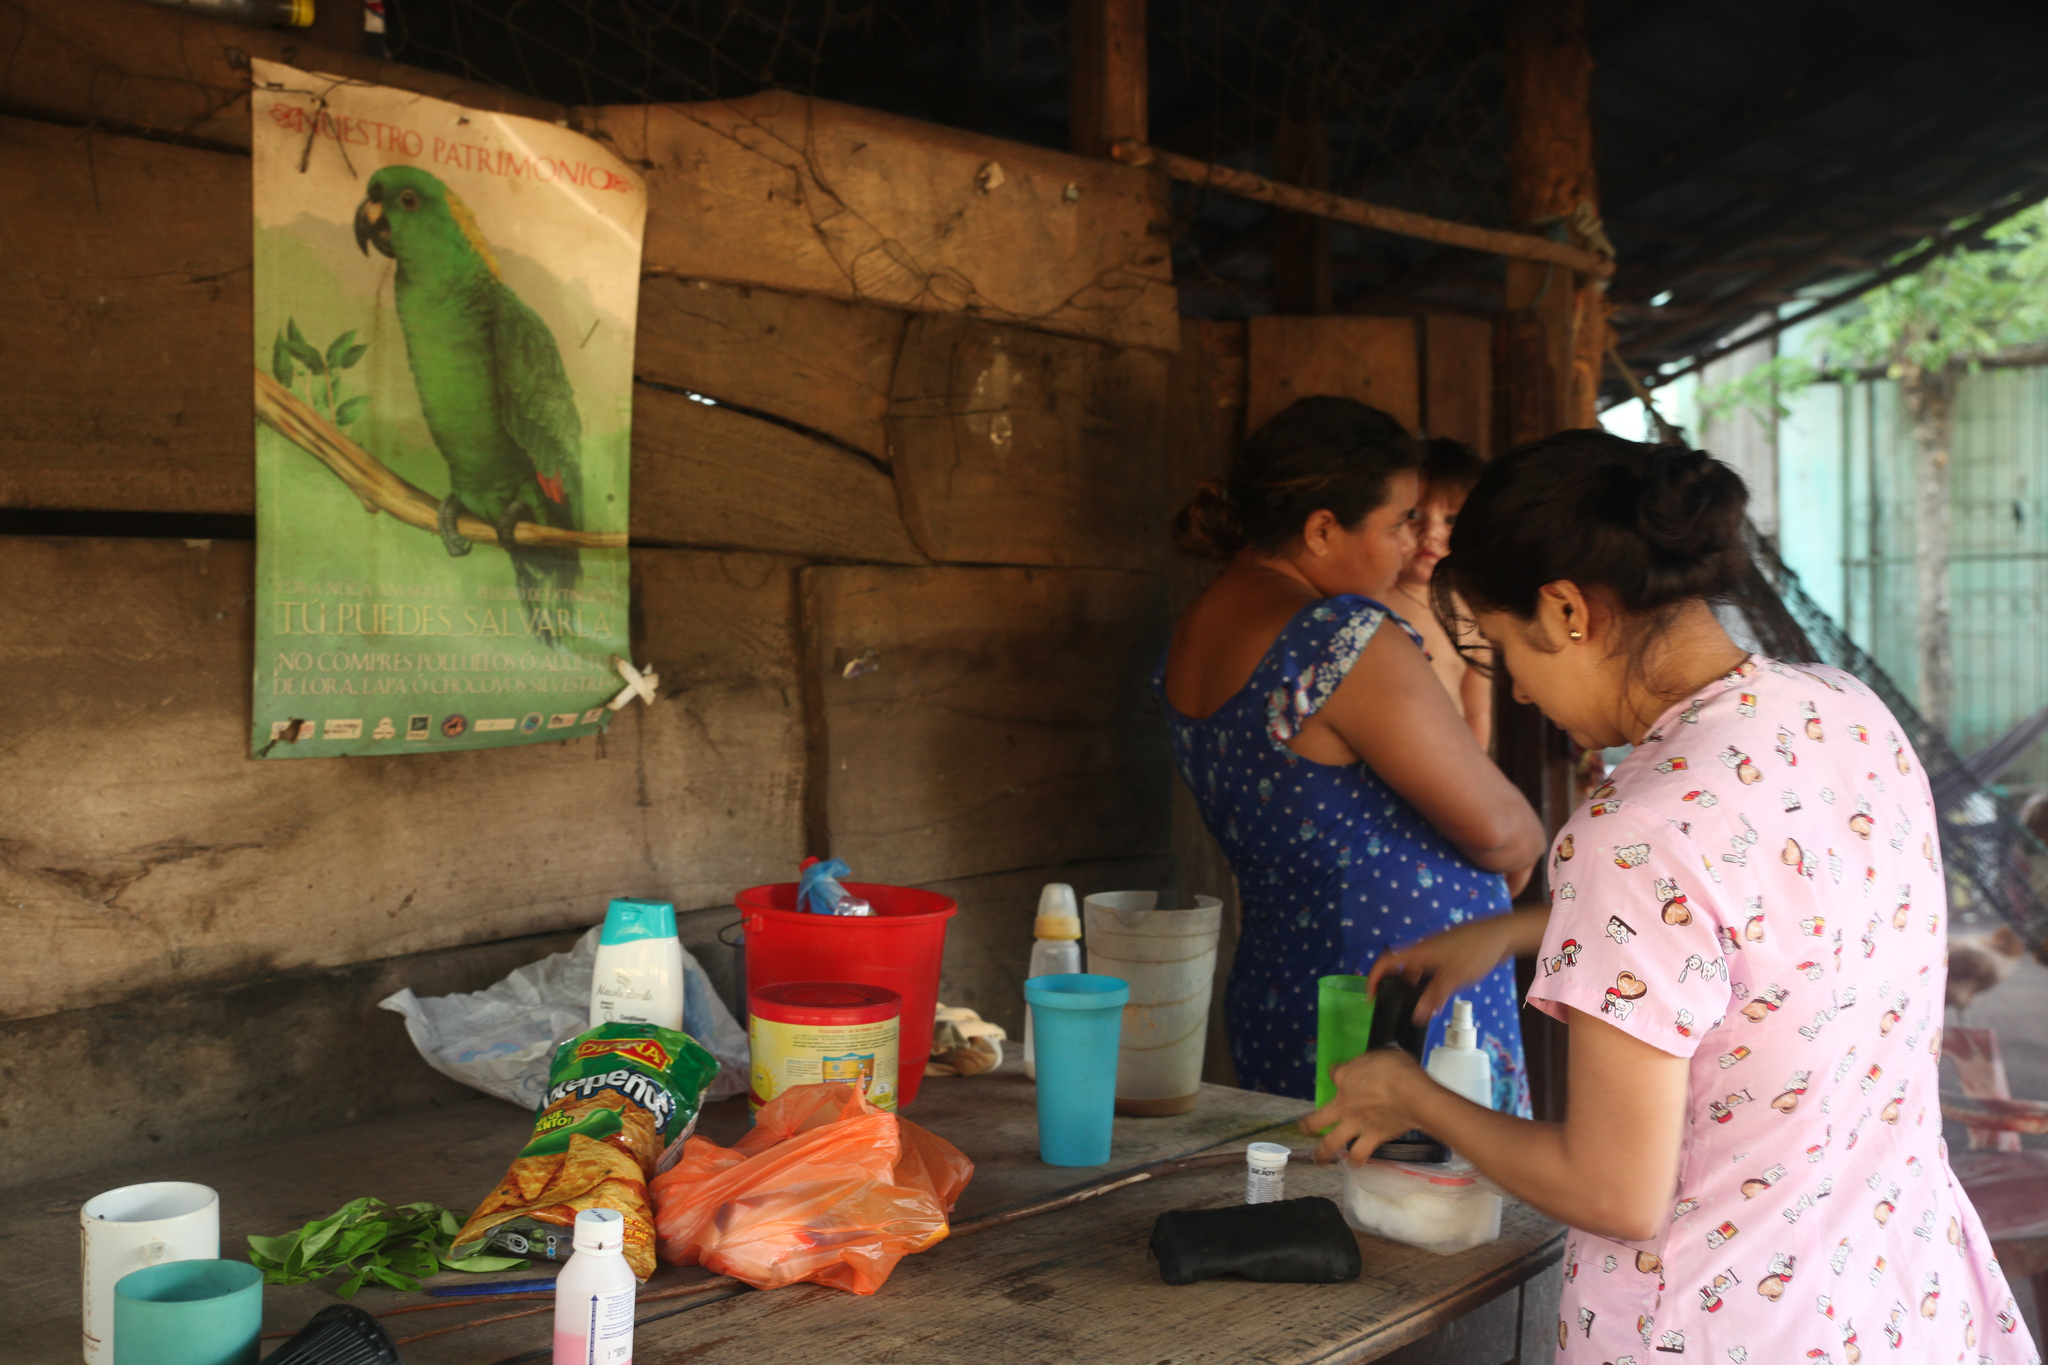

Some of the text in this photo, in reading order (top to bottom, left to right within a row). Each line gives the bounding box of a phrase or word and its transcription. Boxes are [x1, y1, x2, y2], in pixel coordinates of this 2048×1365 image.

[297, 108, 613, 191] NUESTRO PATRIMONIO
[275, 598, 613, 639] TÚ PUEDES SALVARLA
[317, 653, 413, 672] COMPRES
[417, 653, 516, 672] POLLUELOS
[520, 650, 537, 671] Ó
[273, 677, 297, 695] DE
[363, 677, 408, 696] LAPA
[412, 673, 428, 695] Ó
[431, 677, 527, 694] CHOCOYOS
[1617, 976, 1639, 998] Smile
[620, 1014, 648, 1022] Conditioner
[1251, 1168, 1276, 1176] SEJOY
